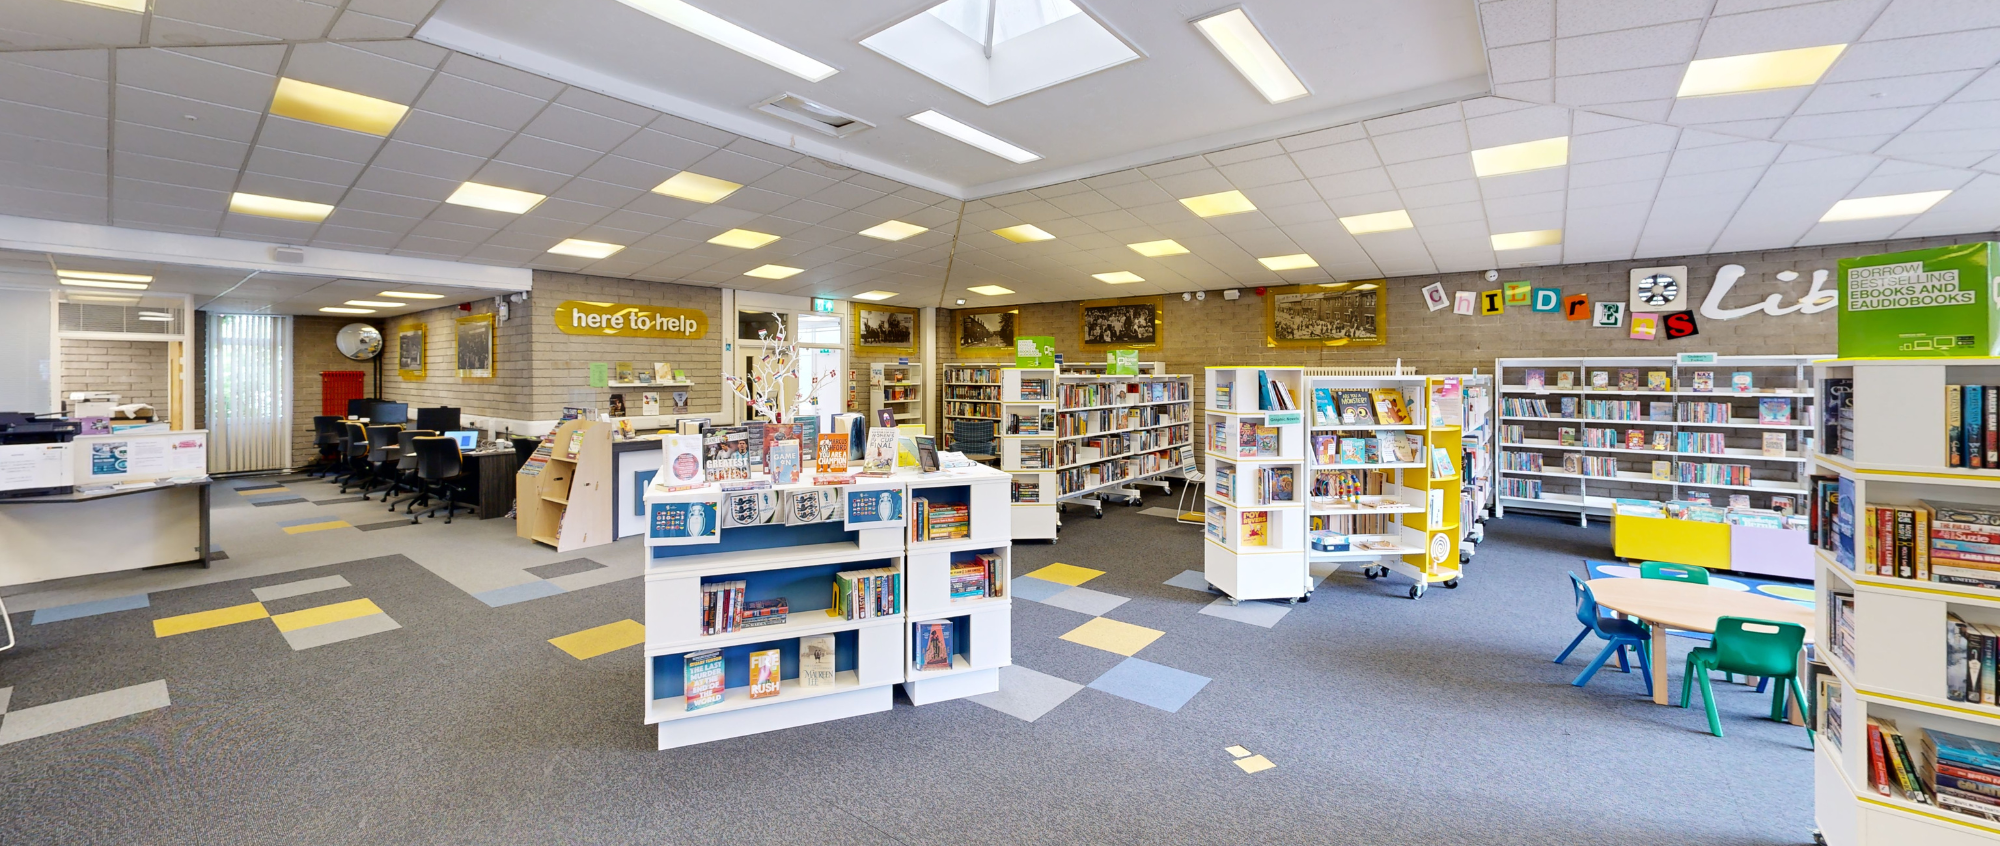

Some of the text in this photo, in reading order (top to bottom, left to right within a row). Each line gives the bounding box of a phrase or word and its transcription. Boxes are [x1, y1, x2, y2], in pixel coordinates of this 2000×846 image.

[1851, 263, 1920, 280] BORROW
[1851, 271, 1955, 289] BESTSELLING
[1851, 283, 1956, 300] EBOOKS AND
[1851, 293, 1972, 310] EAUDIOBOOKS
[572, 307, 697, 336] here to help
[1988, 389, 1997, 413] DARREN
[1988, 414, 1997, 430] SHAN
[773, 452, 796, 460] GAME
[817, 457, 847, 465] CHAMPION
[706, 458, 748, 468] GREATEST
[1955, 531, 1990, 543] Suzie
[751, 653, 779, 669] FIRE
[690, 661, 722, 674] THE LAST
[690, 668, 722, 680] MURDER
[804, 669, 834, 679] MAUREEN
[694, 675, 718, 687] AT THE
[808, 678, 819, 686] LEE
[692, 681, 720, 694] END OF
[751, 682, 779, 694] RUSH
[700, 690, 713, 698] THE
[693, 695, 722, 706] WORLD
